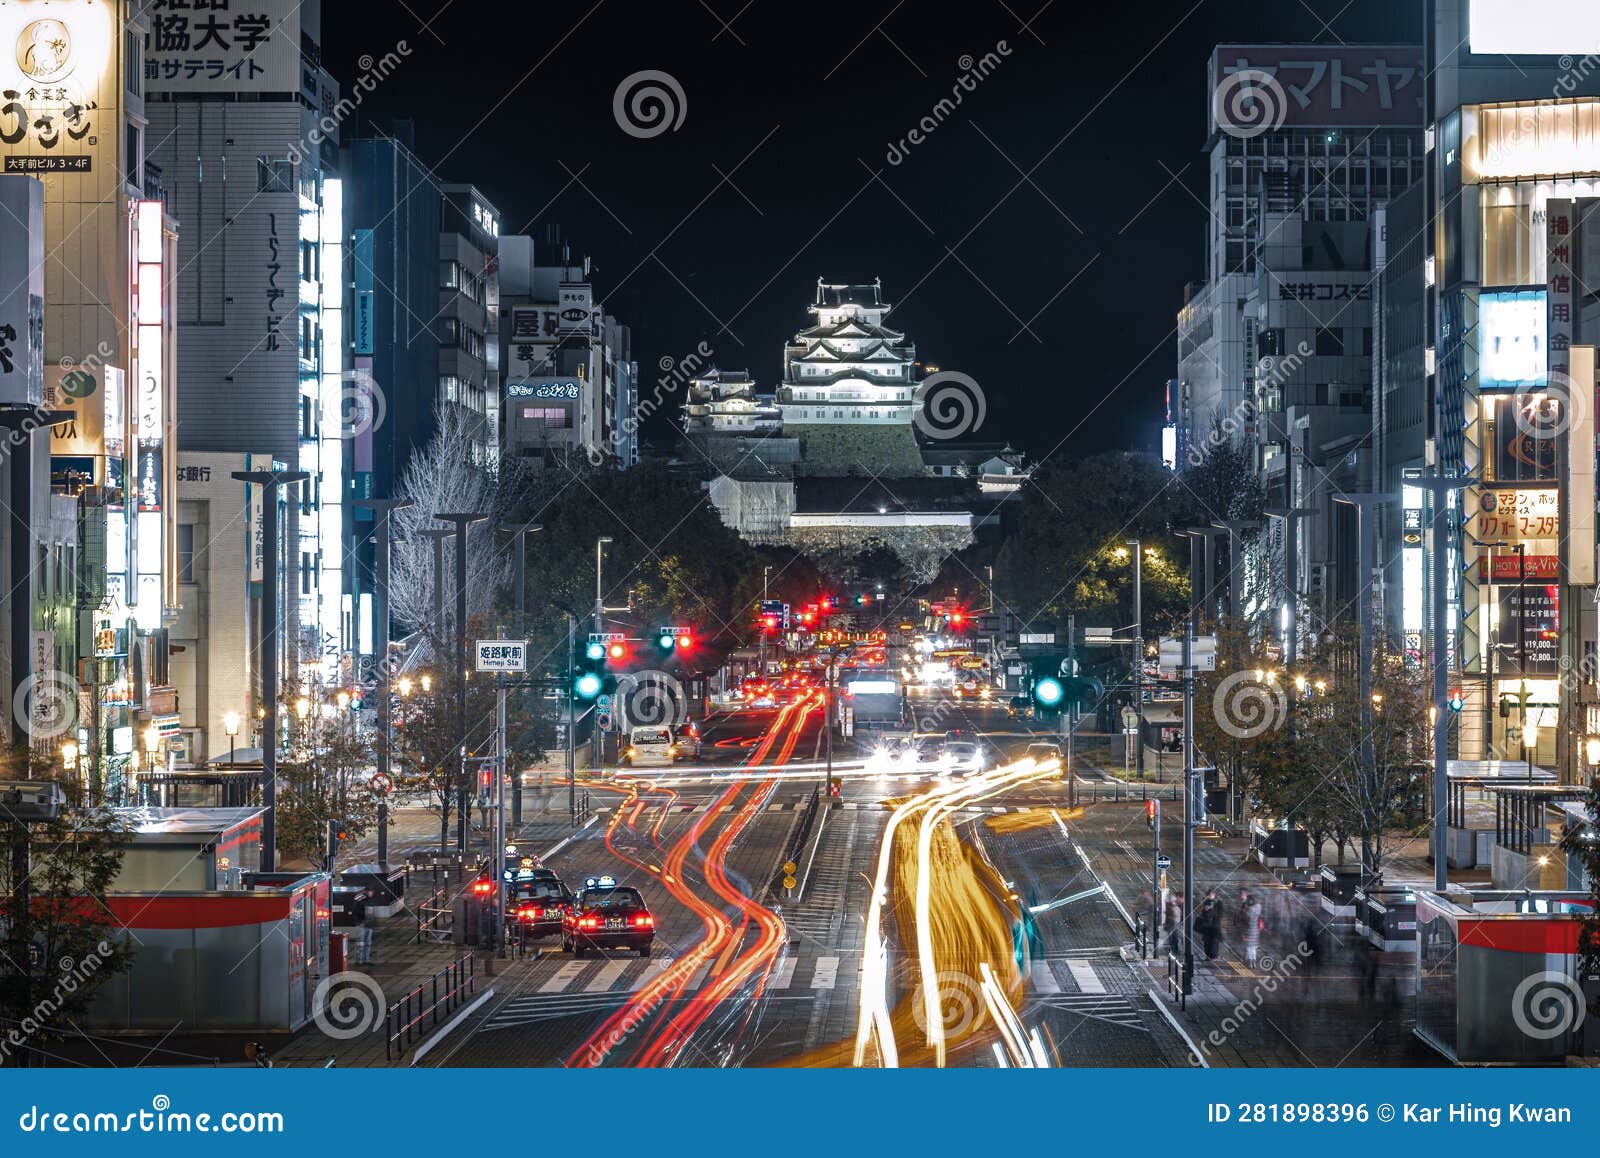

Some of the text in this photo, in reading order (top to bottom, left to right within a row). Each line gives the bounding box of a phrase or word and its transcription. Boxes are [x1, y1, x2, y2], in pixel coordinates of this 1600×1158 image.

[145, 14, 270, 51] 協大学
[0, 89, 97, 149] うさぎ
[9, 159, 88, 168] 大手前ビル 3・4F
[1514, 562, 1538, 571] YGA
[480, 646, 522, 659] 姫路駅前
[483, 659, 504, 667] Himeji
